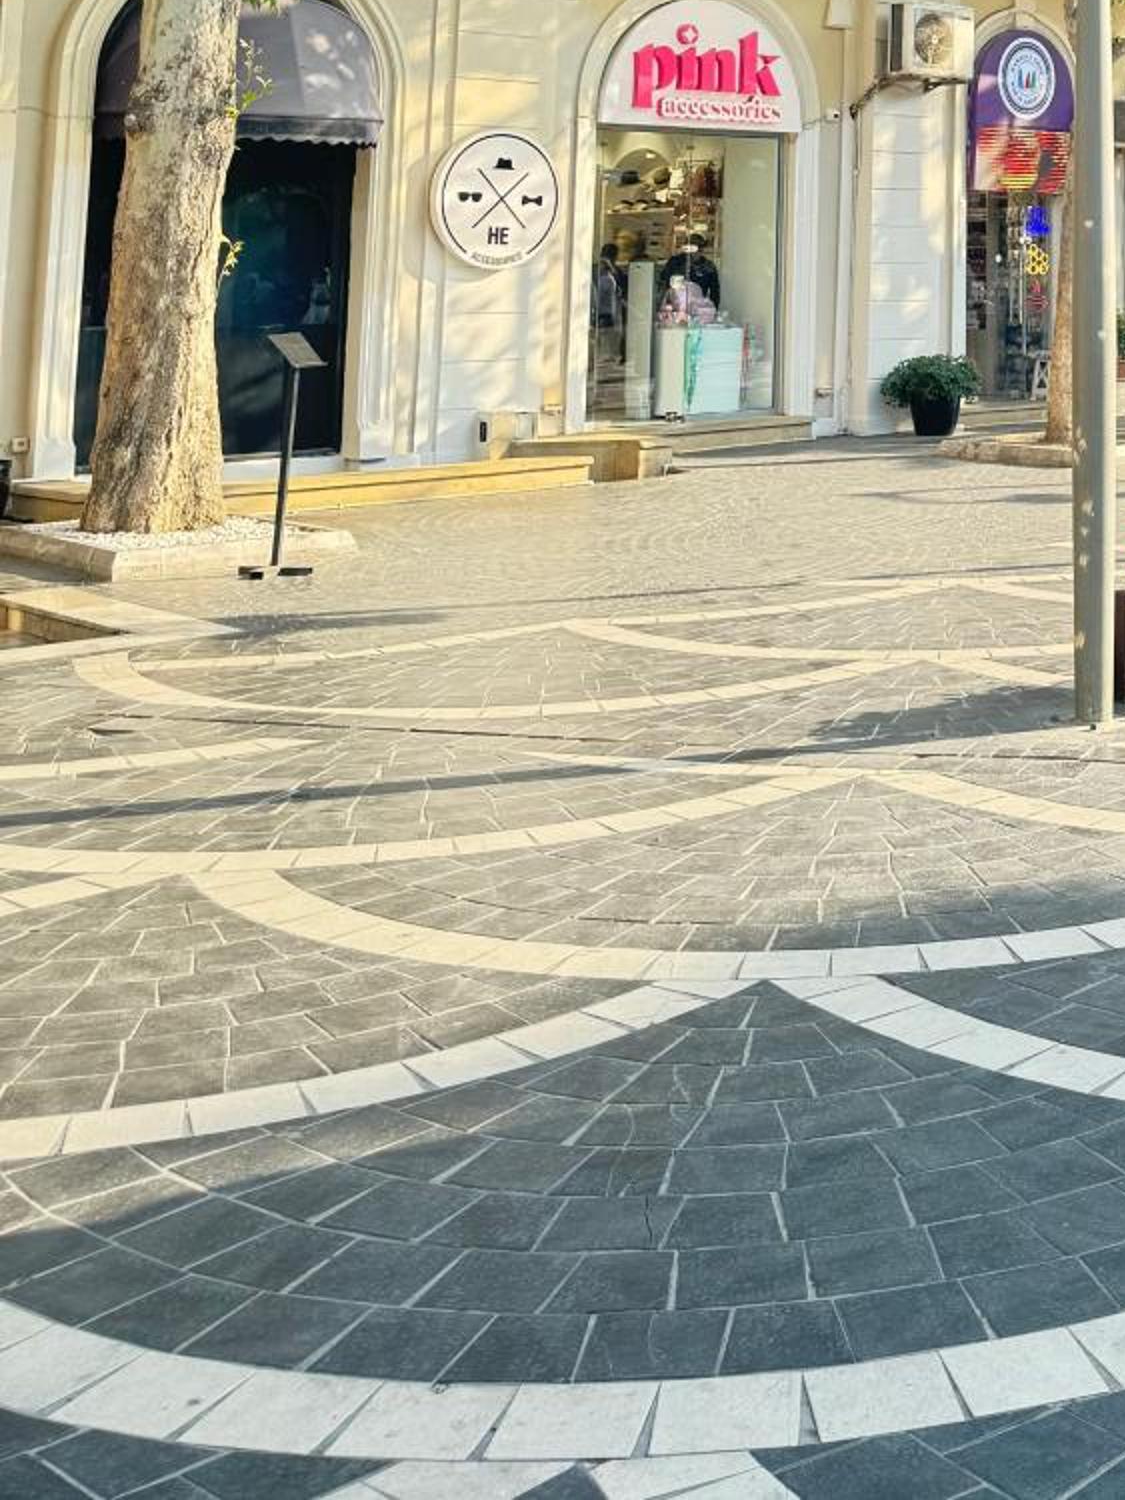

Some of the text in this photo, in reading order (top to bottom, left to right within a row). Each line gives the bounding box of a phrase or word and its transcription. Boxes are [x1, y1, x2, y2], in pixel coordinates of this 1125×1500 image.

[632, 23, 781, 108] pink
[659, 98, 782, 122] accessories
[487, 226, 510, 245] HE
